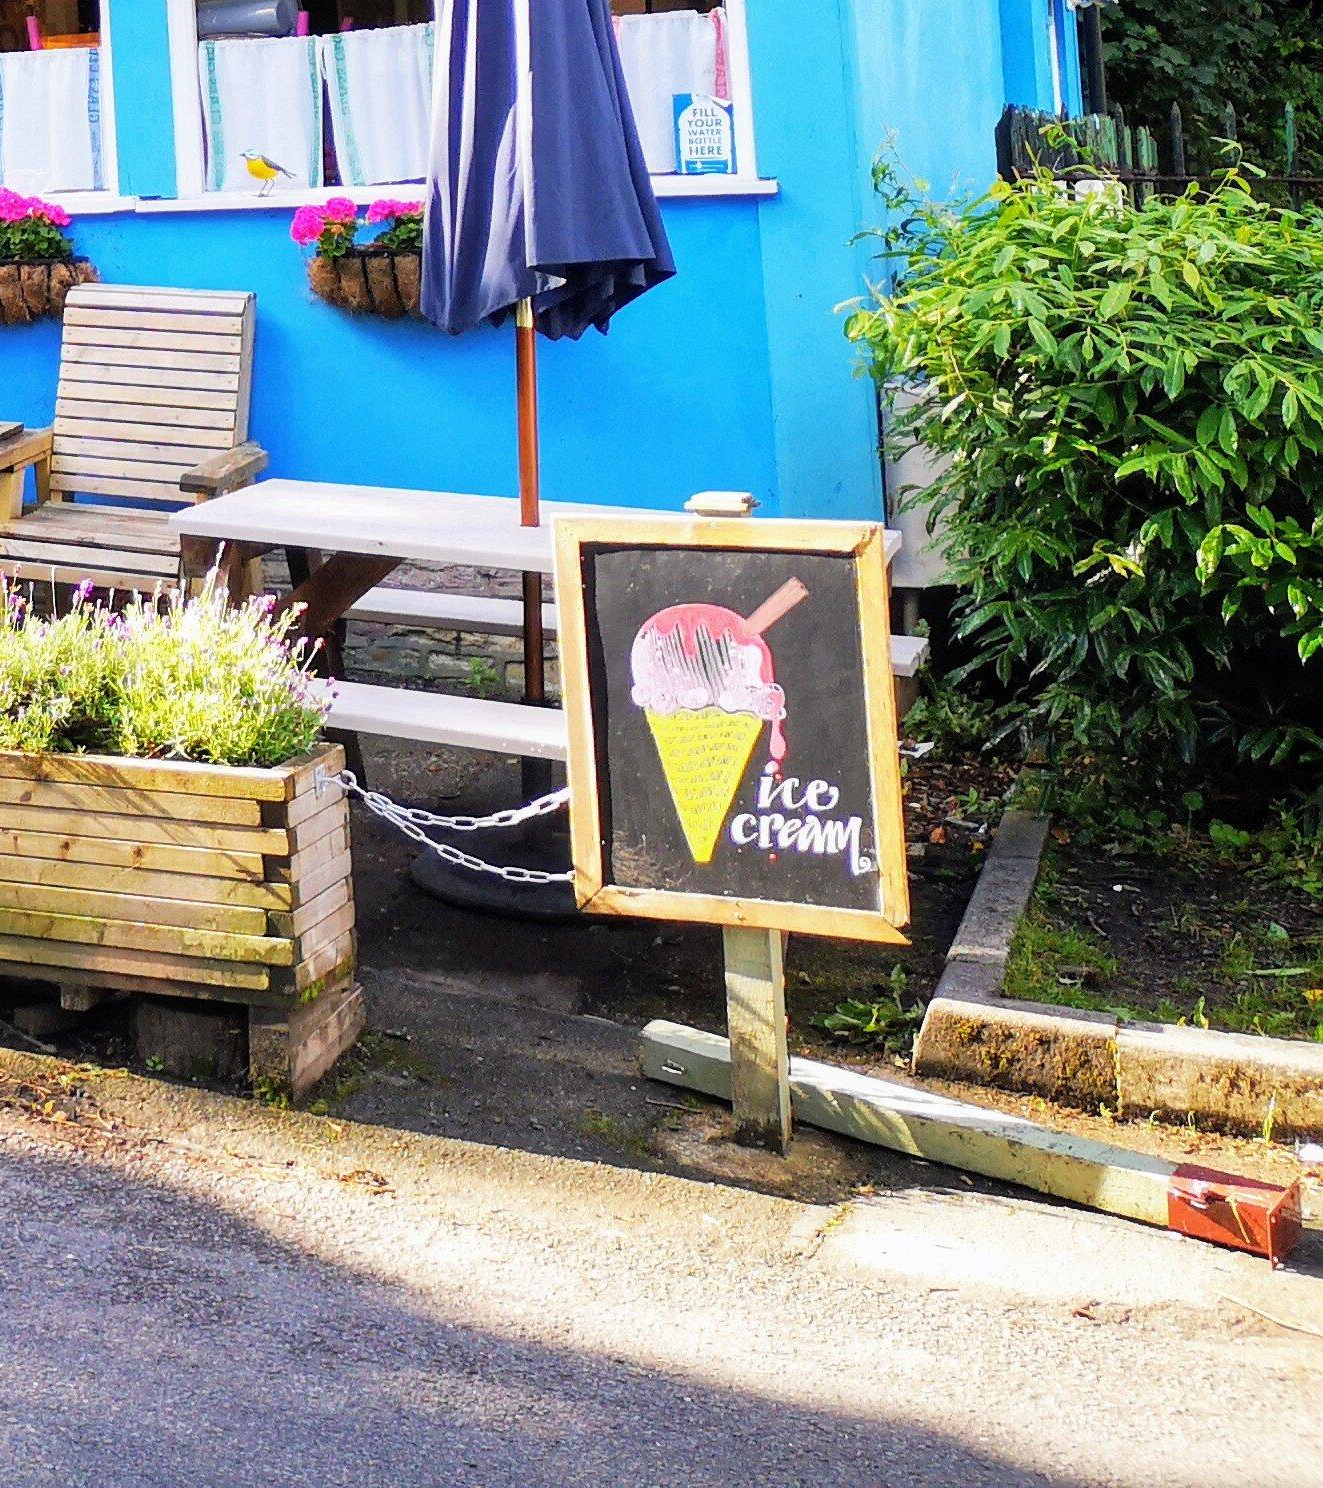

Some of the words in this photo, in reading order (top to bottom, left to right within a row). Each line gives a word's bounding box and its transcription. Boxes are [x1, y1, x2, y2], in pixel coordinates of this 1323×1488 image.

[692, 108, 717, 118] FILL
[687, 118, 723, 128] YOUR
[687, 128, 722, 136] WATER
[688, 146, 723, 156] HERE
[757, 760, 840, 812] ice
[730, 813, 872, 876] cream
